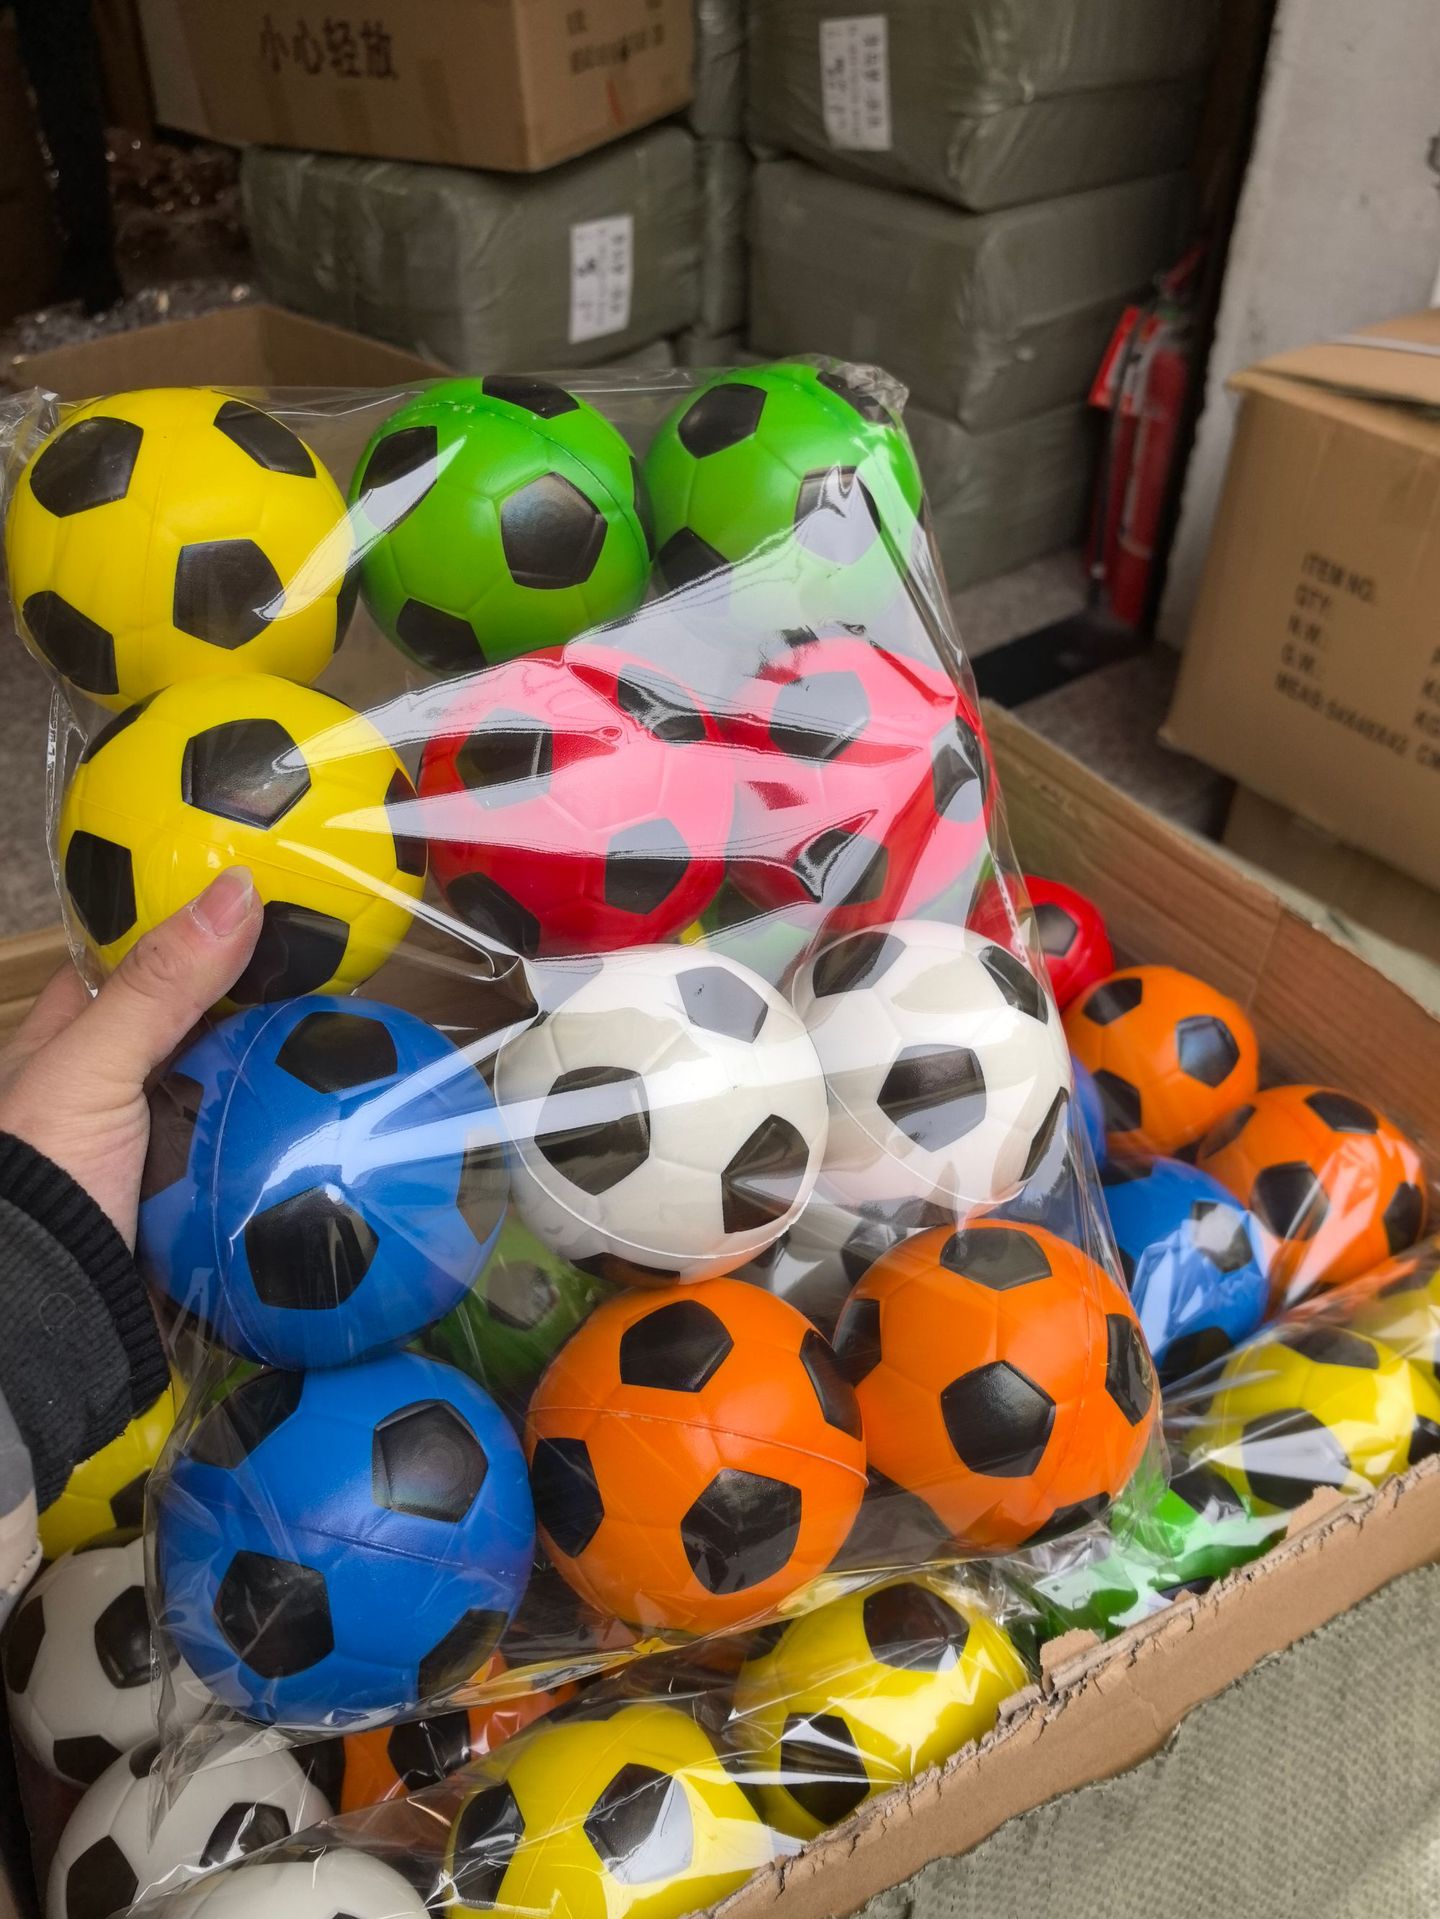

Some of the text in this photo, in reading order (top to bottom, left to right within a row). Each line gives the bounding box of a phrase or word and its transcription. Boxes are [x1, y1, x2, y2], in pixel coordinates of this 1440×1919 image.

[258, 13, 399, 80] 小心轻放
[1301, 552, 1346, 588] ITEM
